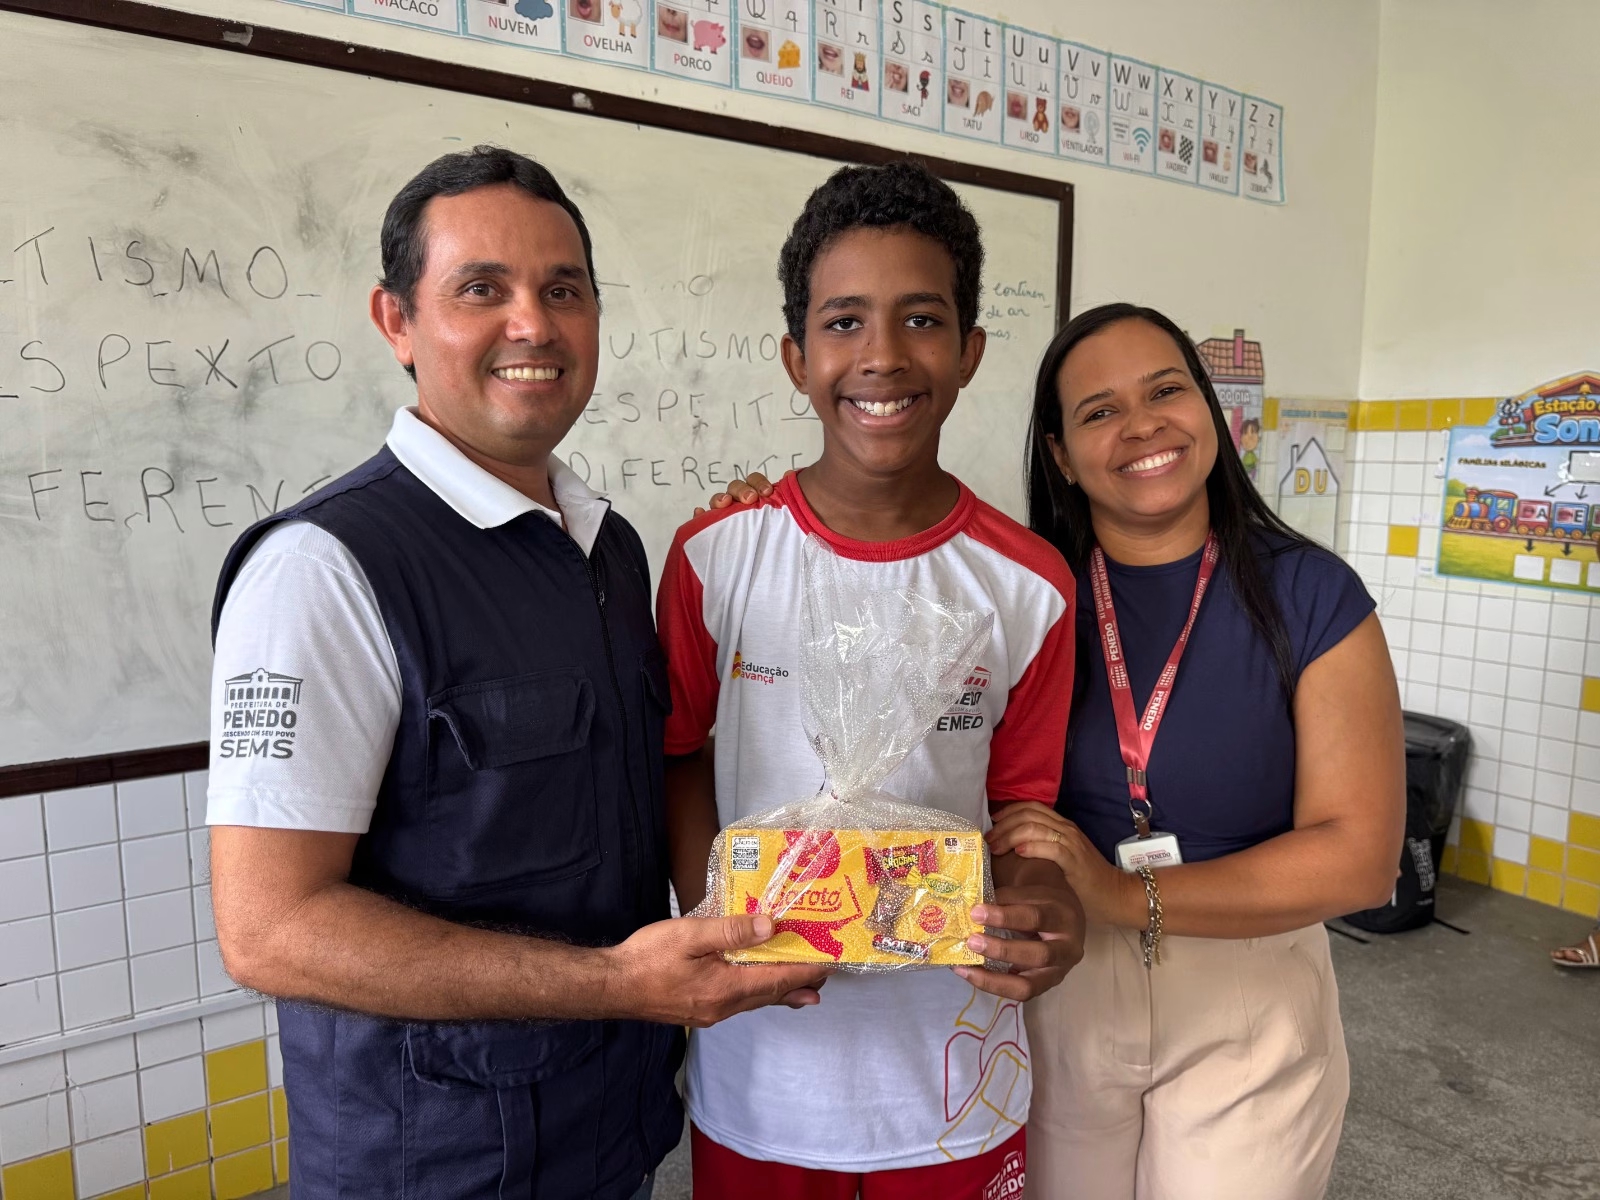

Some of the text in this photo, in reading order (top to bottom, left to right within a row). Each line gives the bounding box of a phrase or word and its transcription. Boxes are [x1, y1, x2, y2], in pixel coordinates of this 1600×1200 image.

[487, 15, 538, 36] NUVEM
[893, 0, 932, 31] S s
[954, 18, 991, 48] T t
[583, 34, 633, 55] OVELHA
[1012, 35, 1049, 63] U u
[673, 53, 712, 73] PORCO
[1068, 49, 1101, 77] V v
[756, 71, 794, 88] QUEIJO
[1114, 62, 1150, 90] W w
[840, 87, 855, 100] REI
[1163, 76, 1193, 103] X x
[901, 103, 921, 117] SACI
[1208, 90, 1236, 117] Y y
[962, 118, 982, 131] TATU
[1248, 103, 1275, 128] Z z
[1019, 130, 1039, 144] URSO
[1061, 139, 1104, 156] VENTILADOR
[609, 327, 778, 364] UTISMO
[1534, 397, 1596, 415] Estação
[1534, 413, 1600, 444] Son
[1536, 505, 1549, 518] A
[1574, 510, 1584, 524] E
[1104, 622, 1120, 662] PENEDO
[740, 670, 774, 686] avança
[741, 661, 789, 678] Educação
[230, 701, 288, 709] PREFEITURA DE
[1143, 690, 1165, 731] PENEDO
[223, 709, 297, 729] PENEDO
[936, 715, 984, 732] EMED
[219, 738, 294, 760] SEMS
